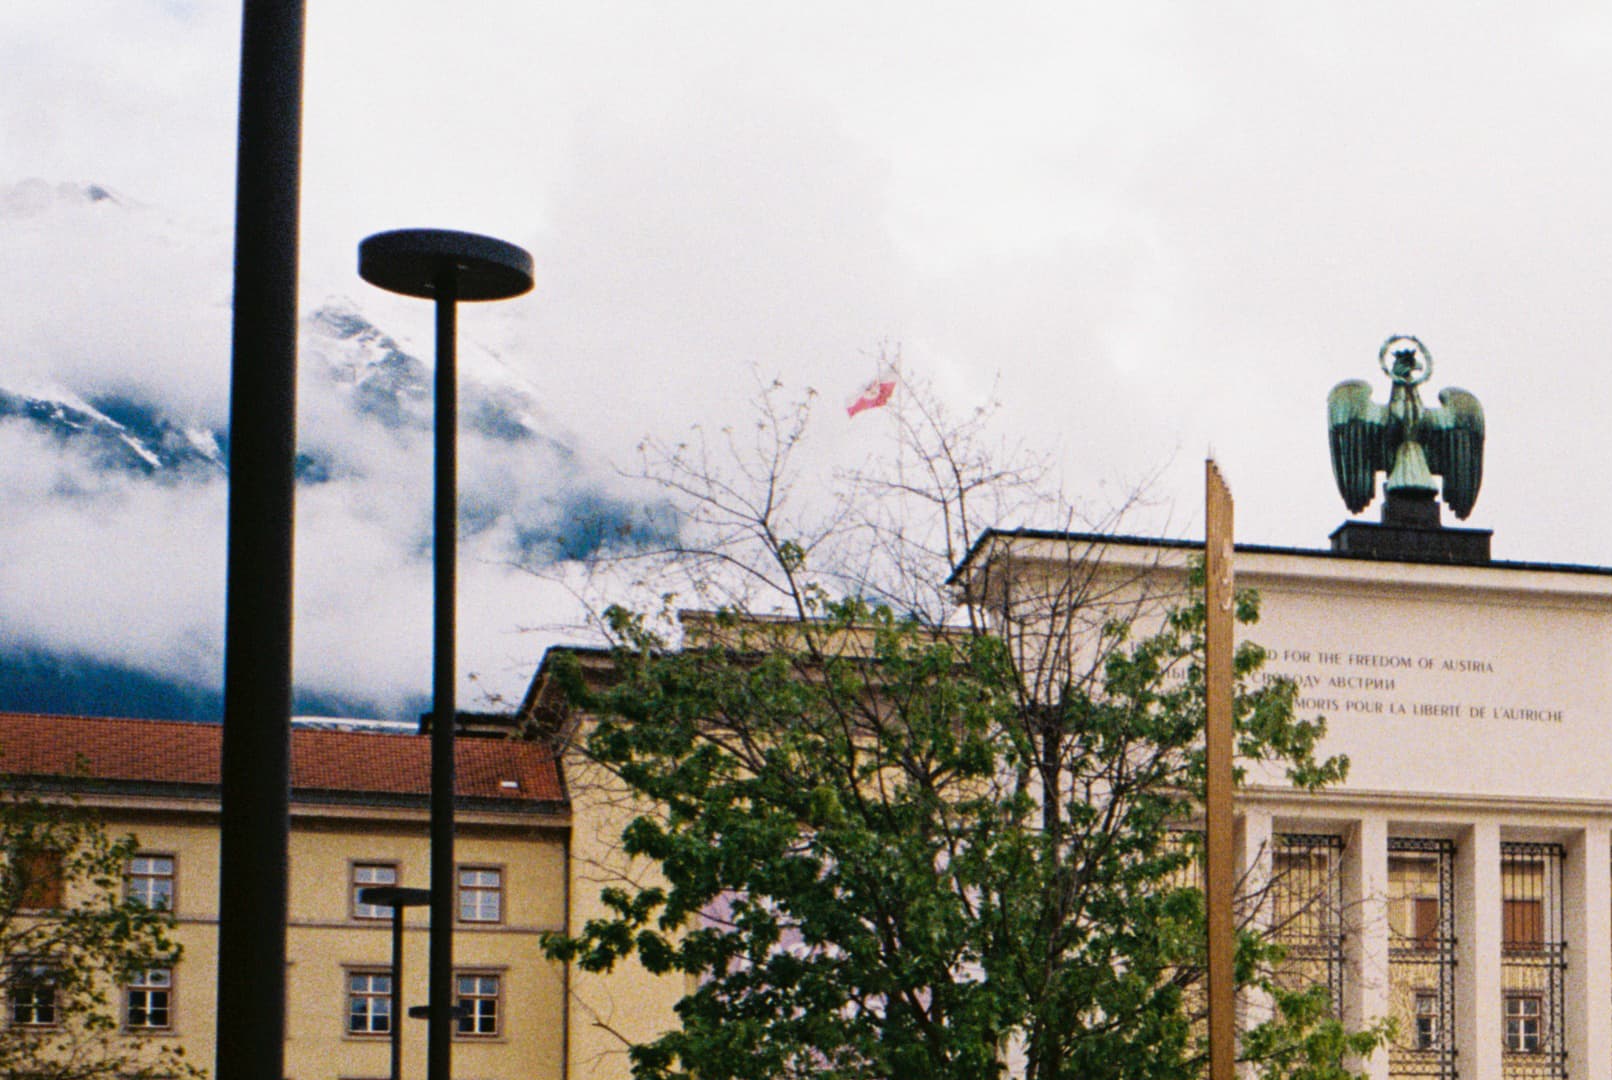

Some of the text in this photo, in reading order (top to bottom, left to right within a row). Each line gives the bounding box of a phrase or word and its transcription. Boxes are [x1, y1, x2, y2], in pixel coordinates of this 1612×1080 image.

[1284, 650, 1311, 663] FOR
[1318, 652, 1340, 665] THE
[1348, 653, 1412, 668] FREEDOM
[1418, 656, 1433, 670] OF
[1441, 658, 1494, 673] AUSTRIA
[1328, 676, 1395, 690] АВСТРИИ
[1293, 698, 1339, 712] MORTS
[1345, 700, 1383, 713] POUR
[1390, 703, 1406, 715] LA
[1470, 705, 1487, 719] DE
[1494, 707, 1564, 723] L'AUTRICHE
